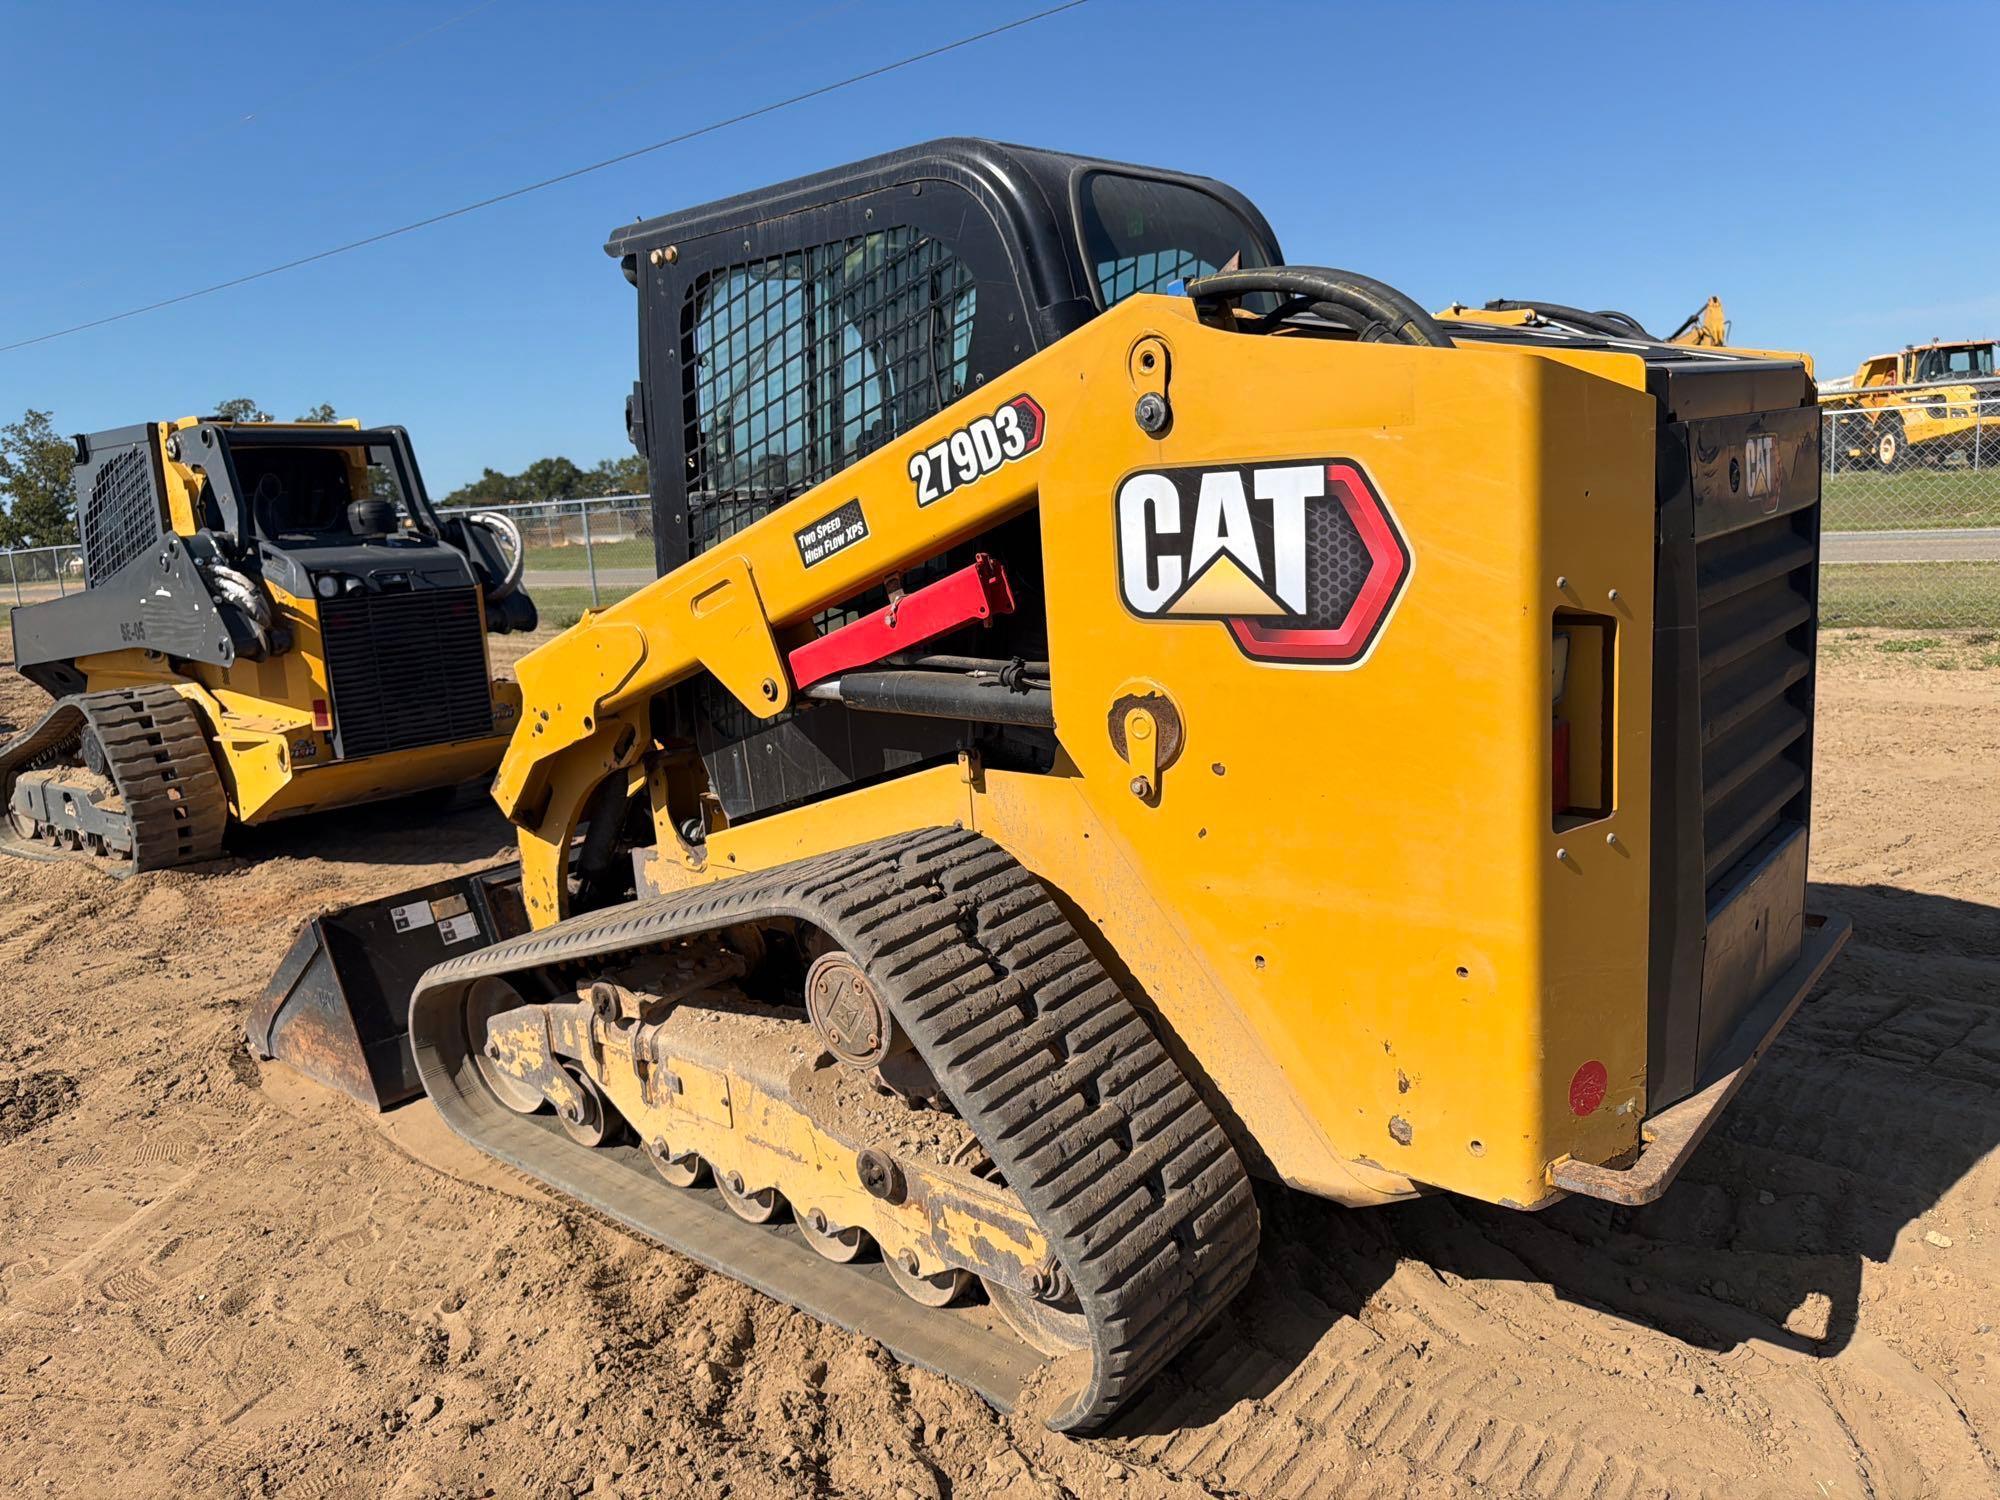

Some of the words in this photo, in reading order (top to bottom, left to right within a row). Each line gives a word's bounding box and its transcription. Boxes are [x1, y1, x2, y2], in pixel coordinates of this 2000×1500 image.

[909, 405, 1026, 504] 279D3
[1745, 437, 1772, 497] CAT
[845, 521, 864, 541] XPS
[1119, 465, 1325, 615] CAT
